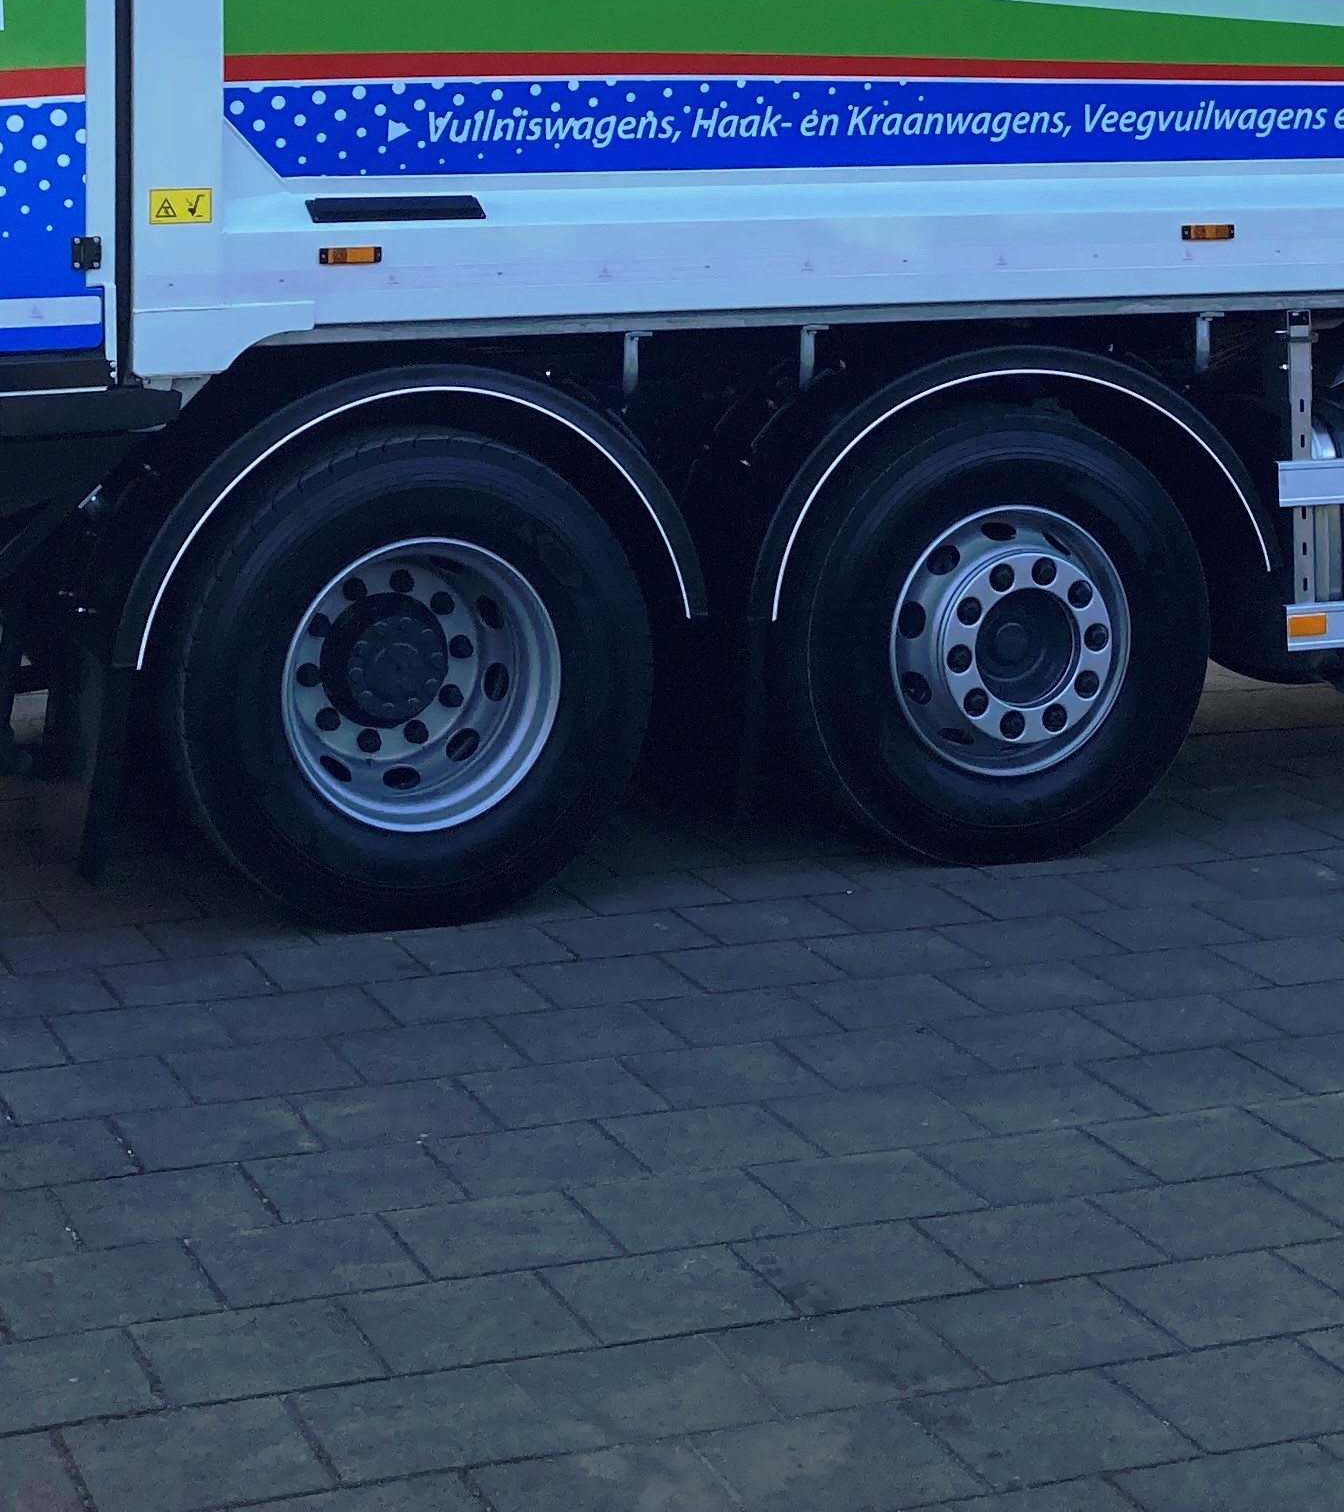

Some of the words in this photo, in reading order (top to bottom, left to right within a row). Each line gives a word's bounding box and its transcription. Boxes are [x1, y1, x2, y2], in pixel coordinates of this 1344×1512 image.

[691, 105, 793, 139] Haak-
[800, 111, 839, 137] en
[846, 105, 1072, 143] Kraanwagens,
[1083, 100, 1327, 141] Veegvuilwagens
